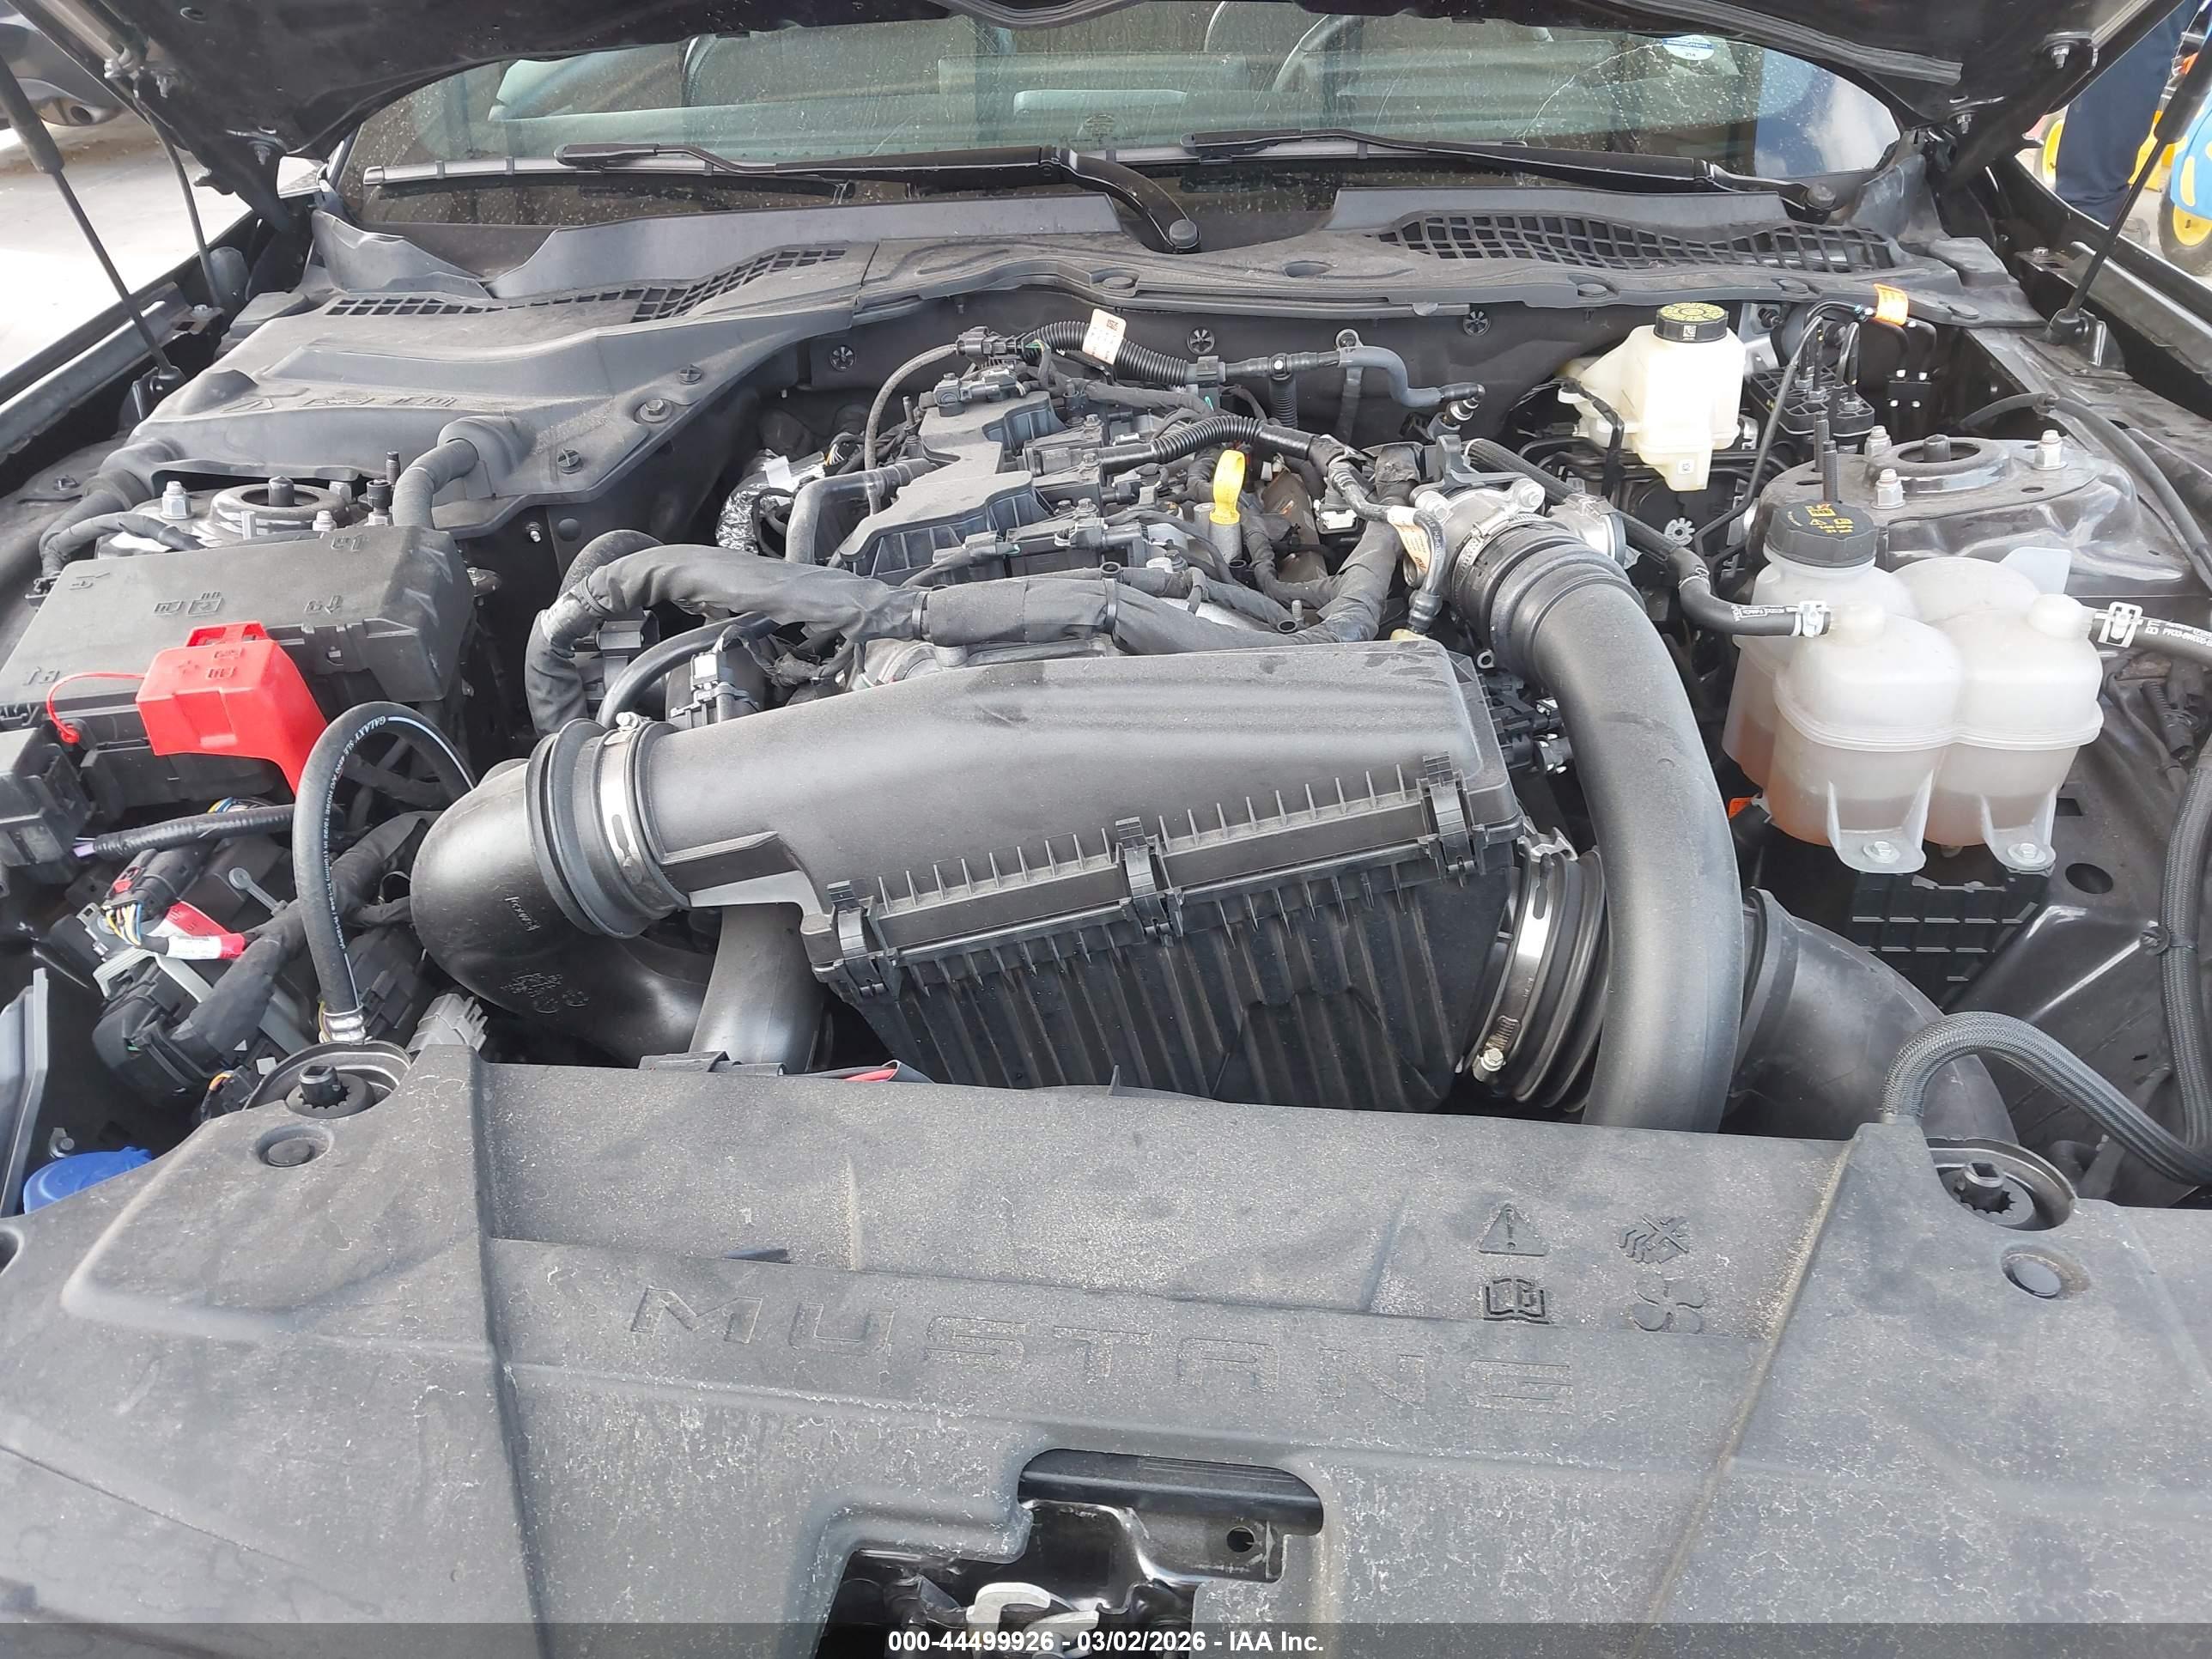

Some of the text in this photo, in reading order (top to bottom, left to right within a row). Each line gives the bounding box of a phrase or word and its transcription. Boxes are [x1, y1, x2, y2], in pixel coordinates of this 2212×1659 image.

[355, 715, 386, 743] GALAXY
[343, 739, 355, 757] SLE
[629, 1285, 1575, 1414] MUSTANG
